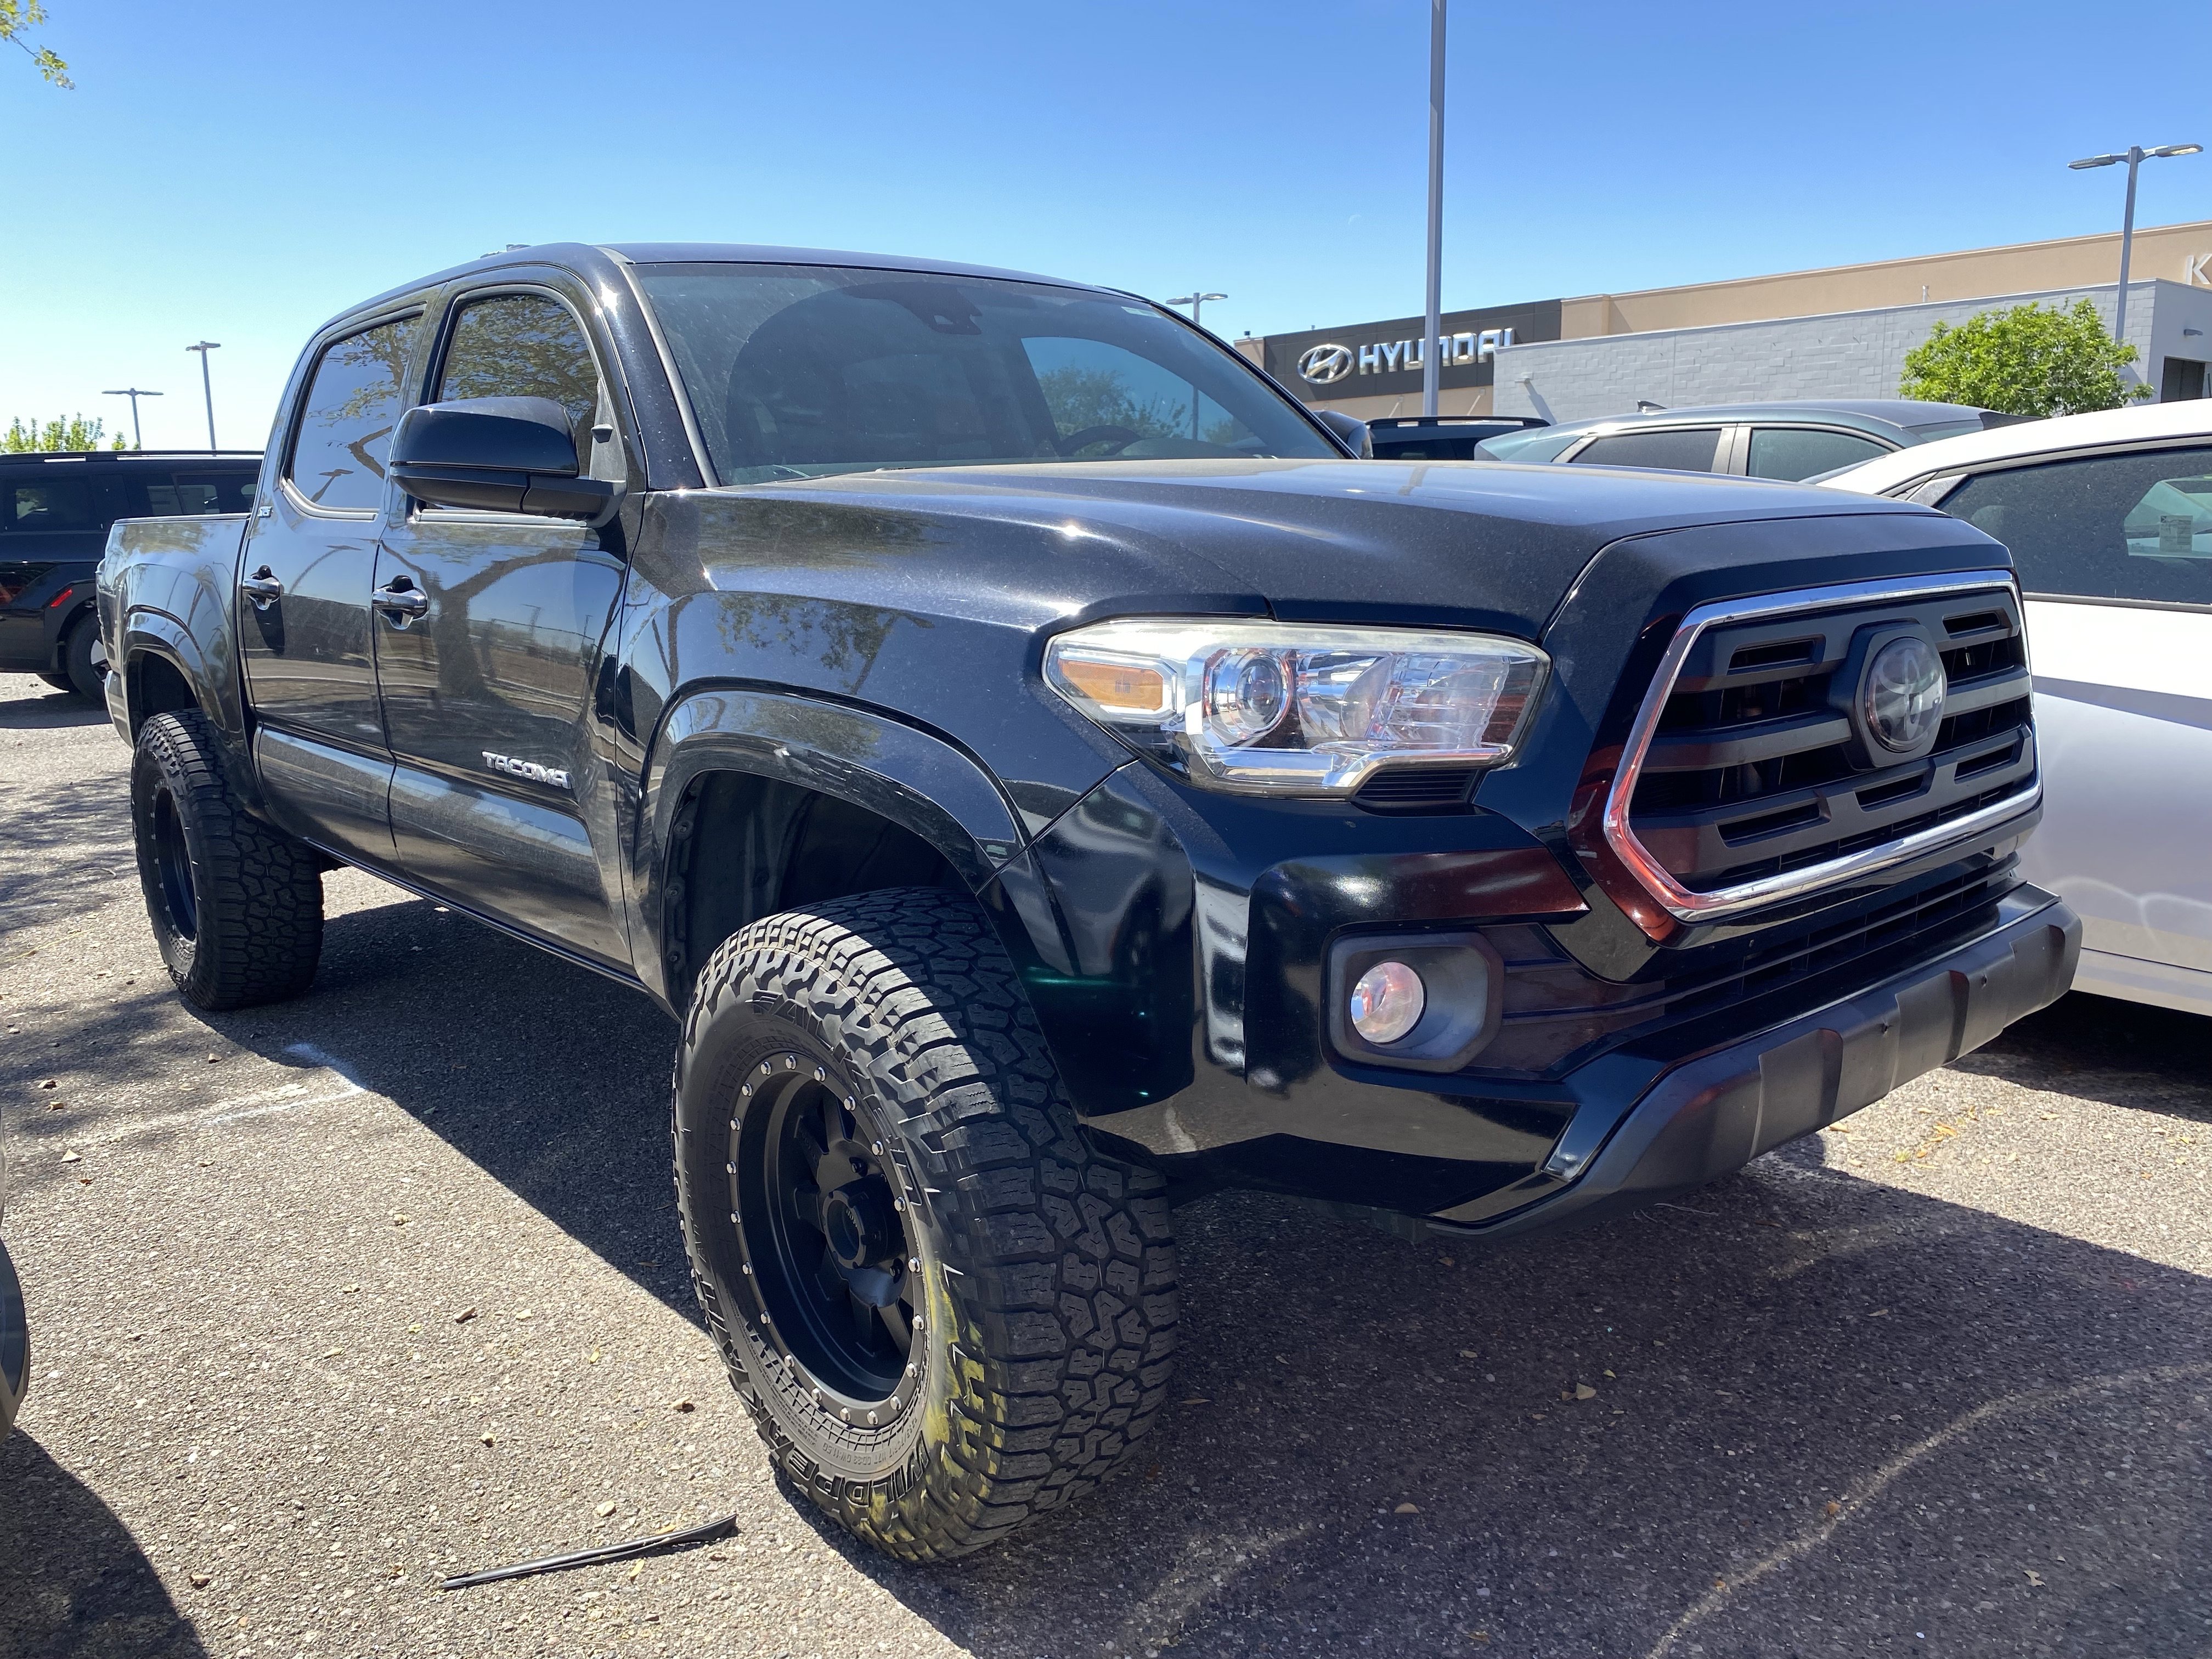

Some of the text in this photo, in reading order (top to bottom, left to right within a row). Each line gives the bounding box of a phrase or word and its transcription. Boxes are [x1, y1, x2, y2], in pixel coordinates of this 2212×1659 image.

[2186, 253, 2212, 285] K
[482, 751, 571, 789] TACOMA
[741, 1384, 929, 1507] WILDPEAK
